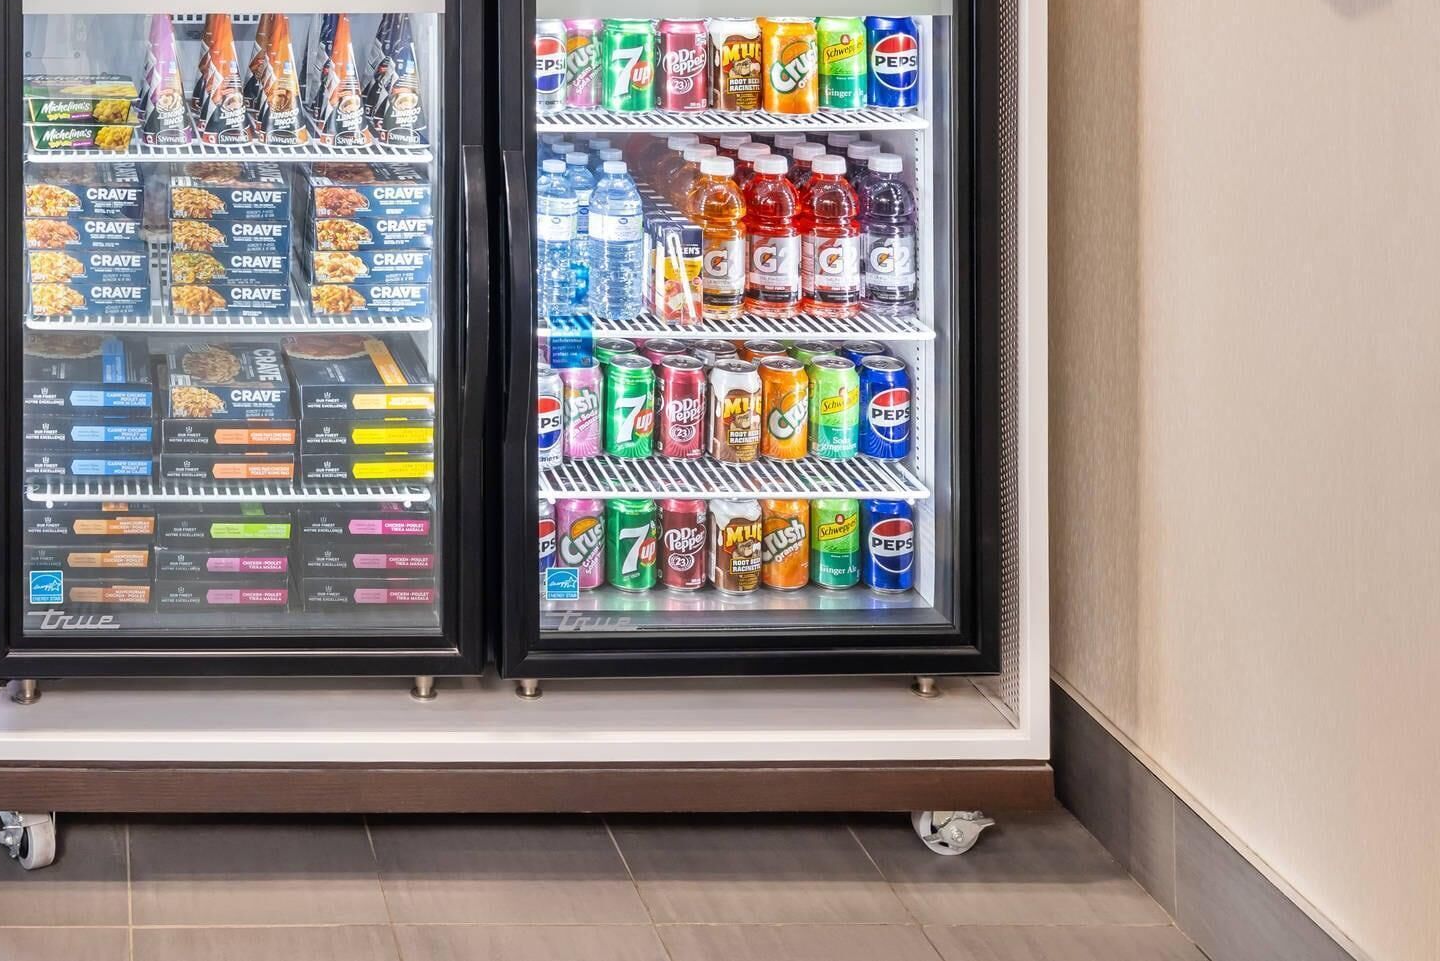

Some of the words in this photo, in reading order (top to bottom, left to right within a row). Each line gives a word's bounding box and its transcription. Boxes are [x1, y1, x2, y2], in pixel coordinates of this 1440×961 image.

[679, 48, 696, 63] Dr
[875, 55, 917, 68] PEPS
[536, 58, 566, 71] EPSI
[667, 52, 706, 77] Pepper
[673, 80, 685, 90] 23
[825, 88, 852, 98] Ginger
[42, 101, 91, 114] Michelina's
[43, 129, 92, 141] Michelina's
[87, 188, 137, 201] CRAVE
[231, 191, 282, 203] CRAVE
[373, 187, 424, 199] CRAVE
[85, 221, 135, 233] CRAVE
[231, 224, 282, 236] CRAVE
[376, 220, 427, 232] CRAVE
[90, 254, 141, 267] CRAVE
[231, 255, 282, 268] CRAVE
[373, 253, 424, 265] CRAVE
[91, 287, 141, 299] CRAVE
[231, 288, 282, 300] CRAVE
[370, 287, 421, 298] CRAVE
[231, 389, 281, 401] CRAVE
[872, 407, 909, 420] PEPS
[676, 428, 687, 437] 23
[681, 527, 697, 540] Dr
[669, 529, 705, 553] Pepper
[872, 538, 913, 551] PEPS
[675, 557, 686, 566] 23
[820, 566, 845, 576] Ginger
